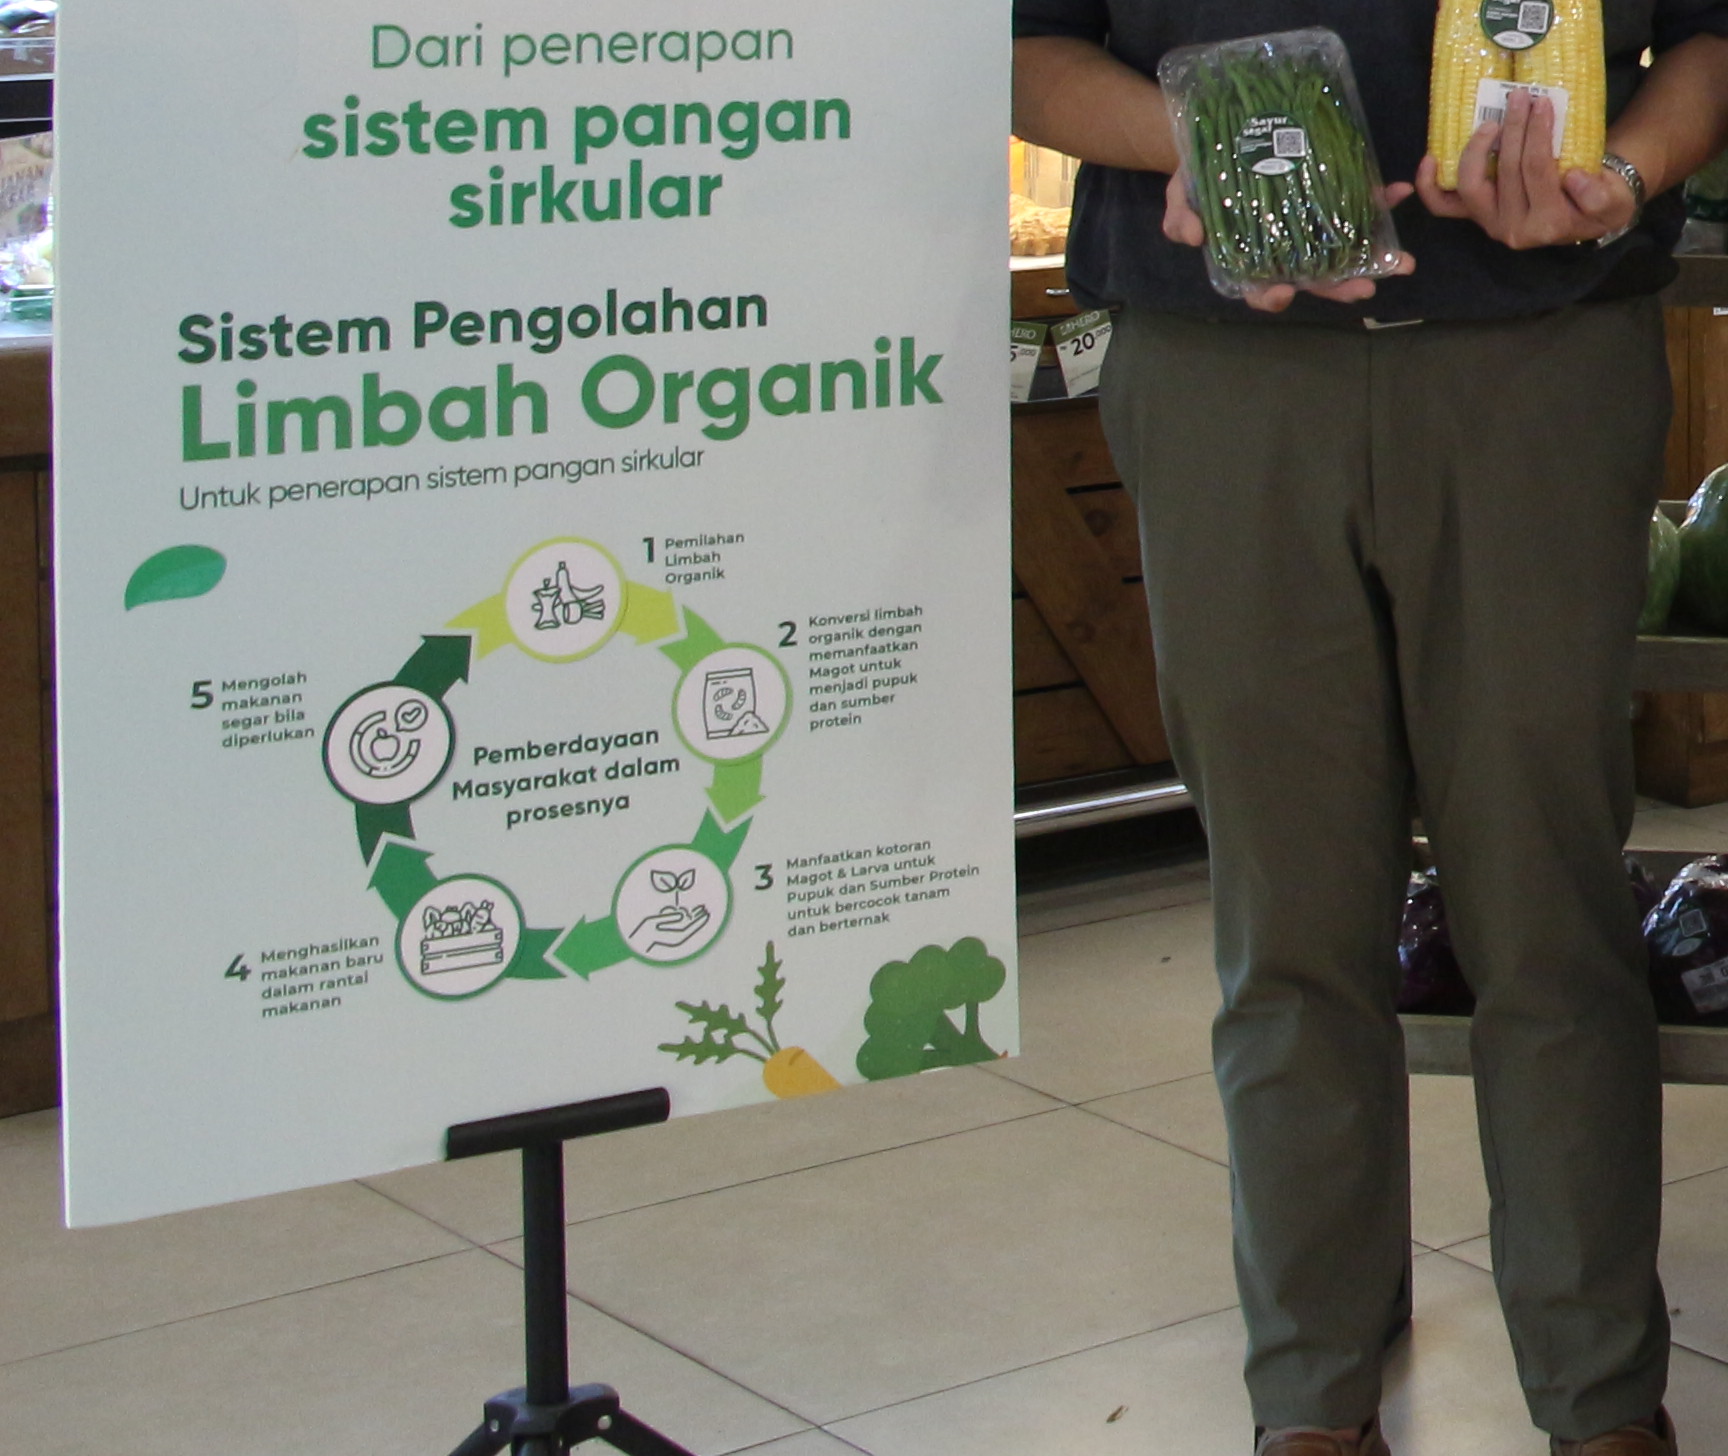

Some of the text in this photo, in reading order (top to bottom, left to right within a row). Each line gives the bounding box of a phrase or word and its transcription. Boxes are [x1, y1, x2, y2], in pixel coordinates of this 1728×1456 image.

[371, 23, 793, 76] Dari penerapan
[302, 89, 852, 159] sistem pangan
[448, 160, 723, 229] sirkular
[177, 288, 768, 364] Sistem Pengolahan
[182, 337, 944, 462] Limbah Organik
[179, 445, 705, 512] Untuk penerapan sistem pangan sirkular
[642, 536, 655, 563] 1
[665, 532, 744, 549] Pemilahan
[665, 552, 721, 567] Limbah
[665, 569, 725, 585] Organik
[808, 605, 923, 627] Konversi limbah
[778, 621, 798, 648] 2
[808, 623, 922, 645] organik dengan
[808, 640, 919, 661] memanfaatkan
[221, 671, 308, 695] Mengolah
[809, 658, 902, 681] Magot untuk
[190, 680, 214, 710] 5
[809, 672, 918, 697] menjadi pupuk
[221, 691, 302, 712] makanan
[809, 692, 895, 713] dan sumber
[221, 709, 305, 731] segar bila
[810, 713, 862, 731] protein
[222, 726, 315, 749] diperlukan
[472, 729, 660, 767] Pemberdayaan
[452, 756, 680, 801] Masyarakat dalam
[506, 795, 630, 830] prosesnya
[786, 840, 931, 870] Manfaatkan kotoran
[754, 864, 774, 890] 3
[786, 855, 936, 887] Magot & Larva untuk
[787, 864, 980, 903] Pupuk dan Sumber Protein
[787, 886, 950, 920] untuk bercocok tanam
[787, 912, 891, 938] dan berternak
[261, 936, 380, 963] Menghasilkan
[224, 953, 252, 982] 4
[261, 953, 384, 982] makanan baru
[261, 970, 369, 1000] dalam rantai
[262, 996, 341, 1018] makanan
